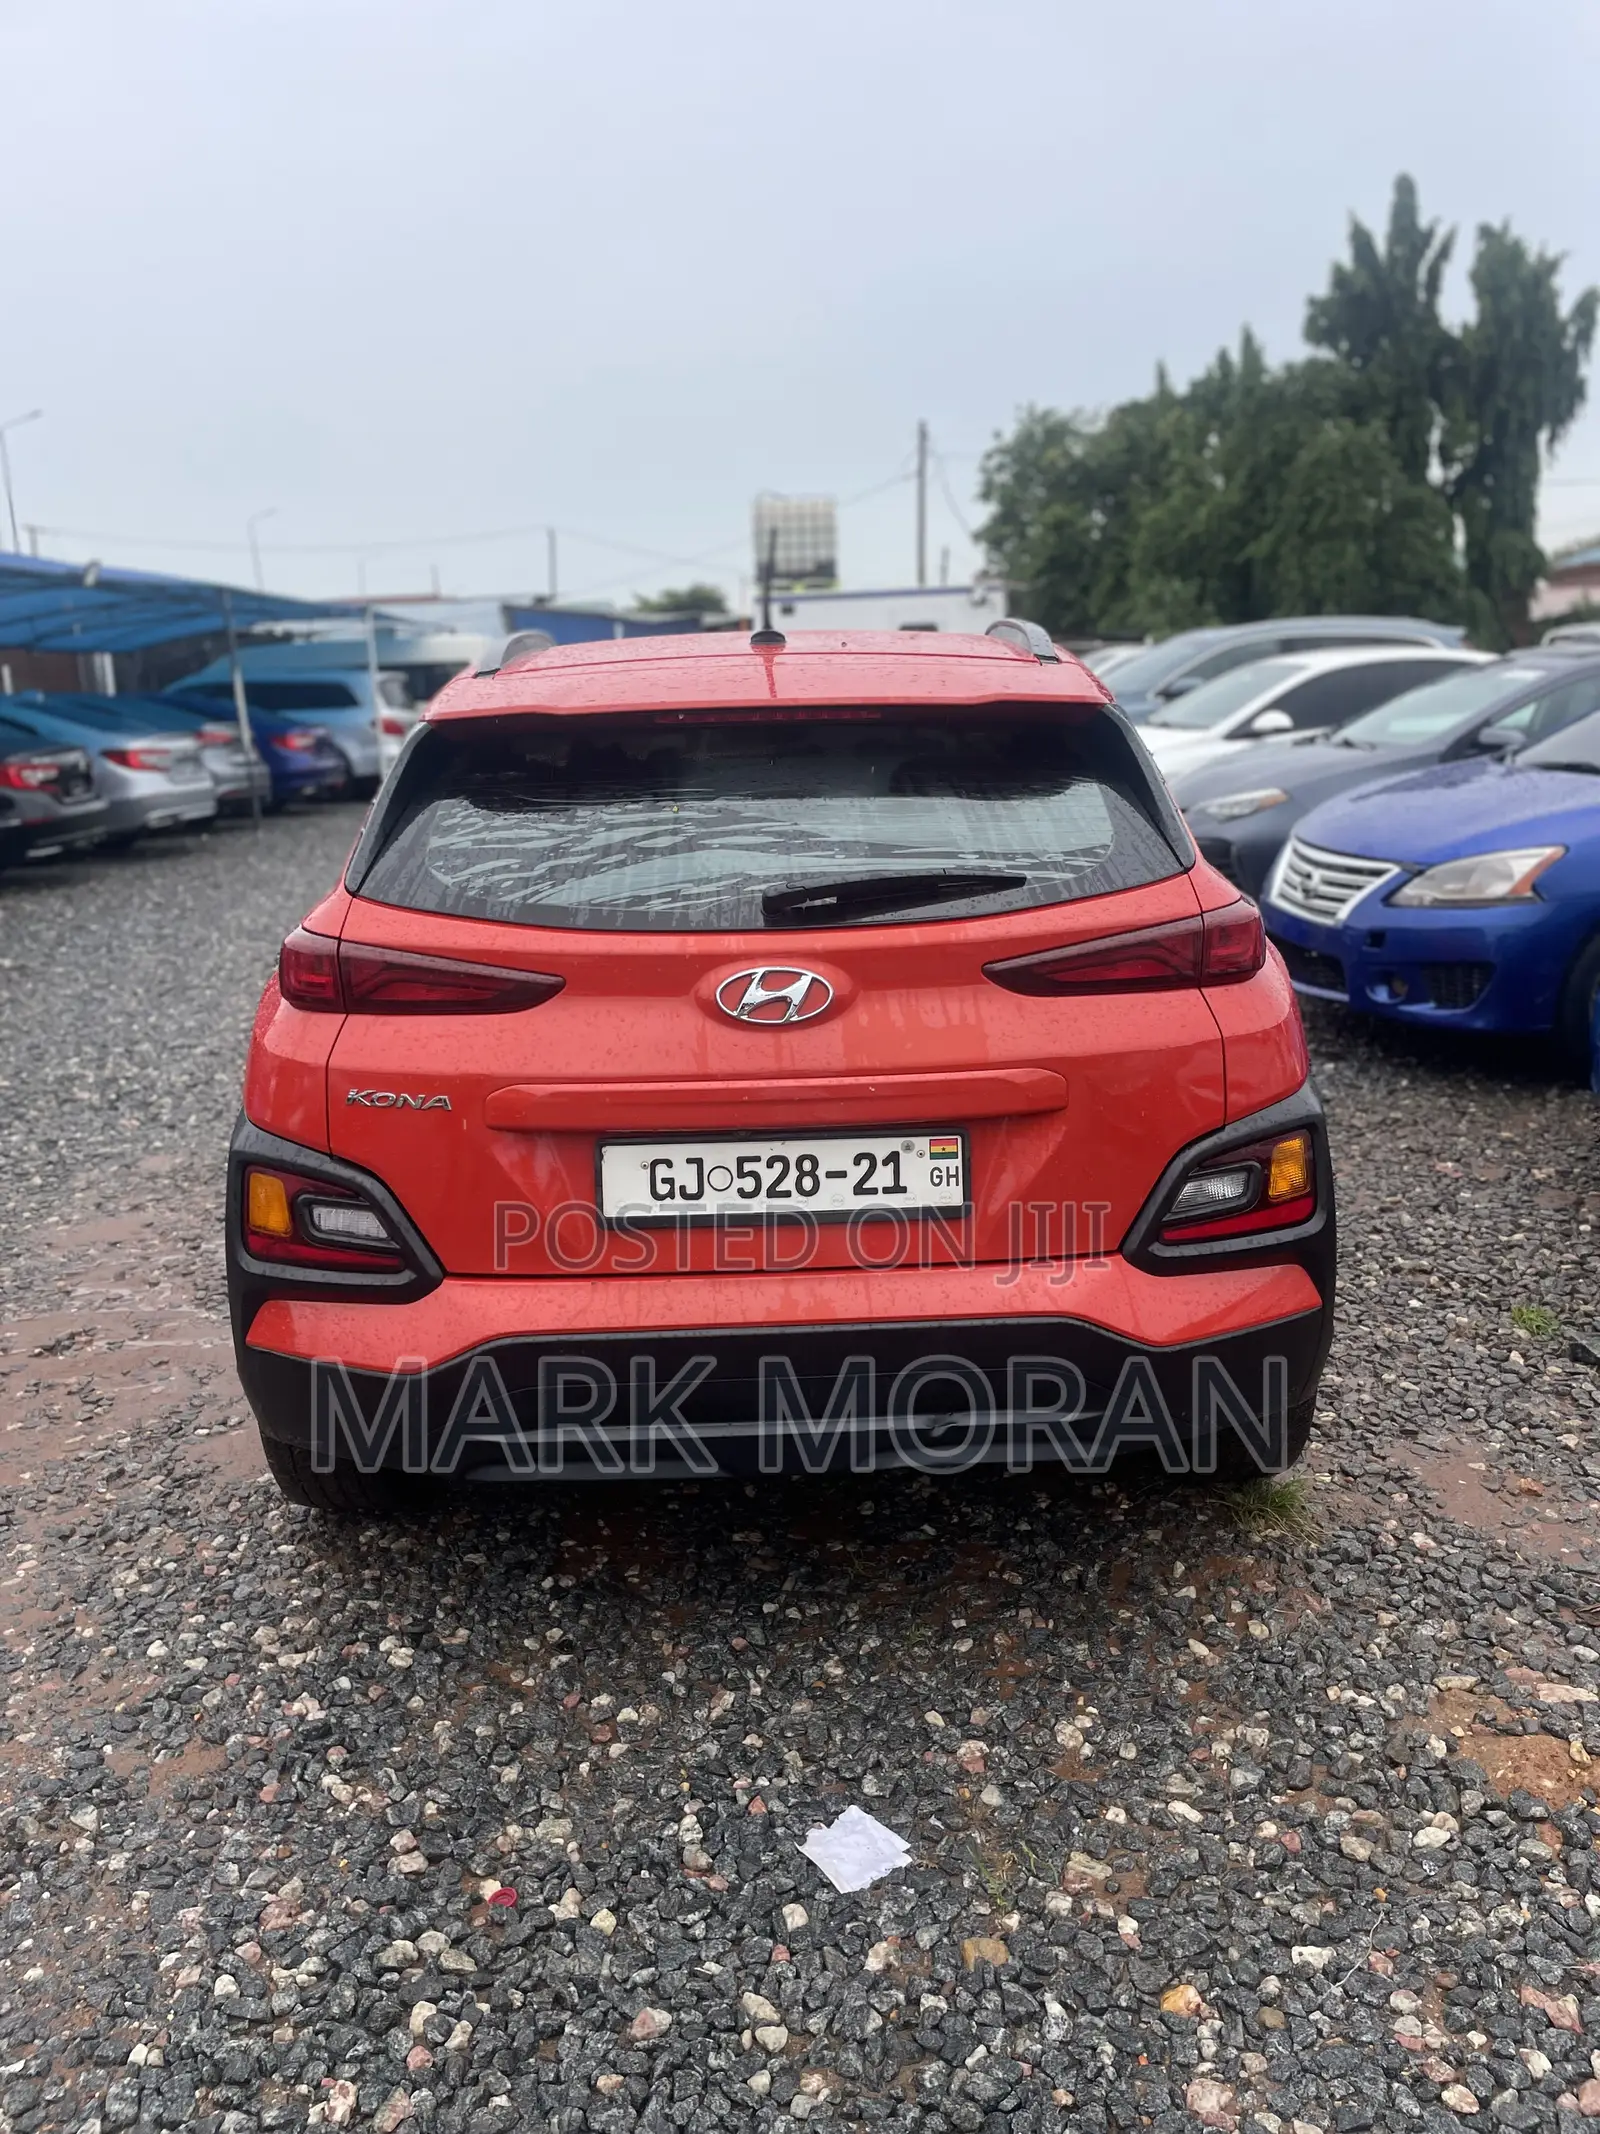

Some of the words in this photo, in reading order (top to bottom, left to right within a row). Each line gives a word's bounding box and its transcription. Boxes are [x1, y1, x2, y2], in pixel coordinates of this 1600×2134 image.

[345, 1088, 452, 1111] KONA
[736, 1150, 908, 1199] 528-21
[929, 1165, 960, 1188] GH
